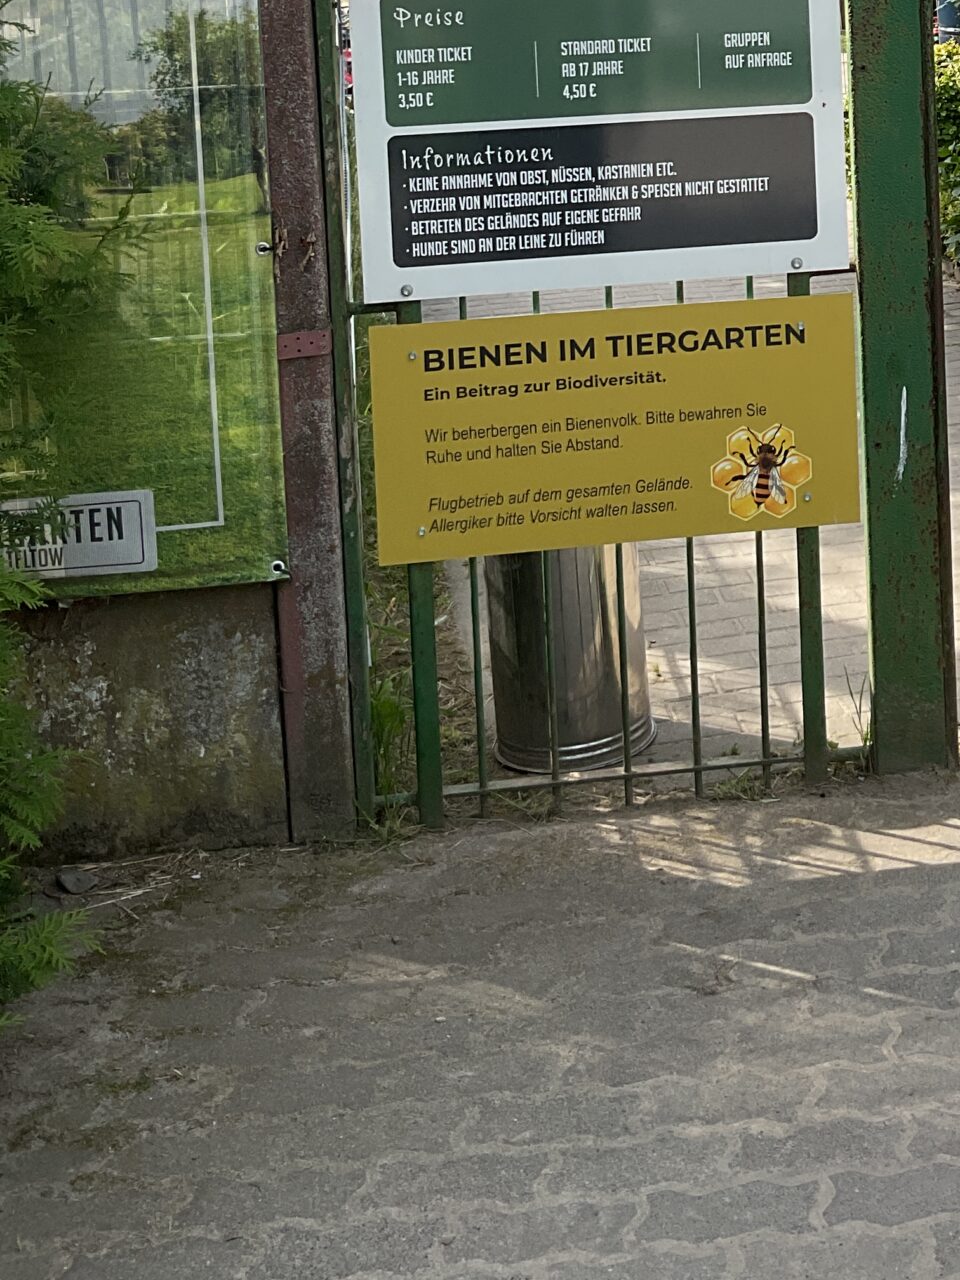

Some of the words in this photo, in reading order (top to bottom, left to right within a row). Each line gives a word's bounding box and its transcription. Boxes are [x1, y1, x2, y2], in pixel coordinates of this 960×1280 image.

[394, 7, 464, 28] Preise
[561, 40, 615, 56] STANDARD
[618, 37, 651, 53] TICKET
[724, 32, 770, 48] GRUPPEN
[396, 49, 435, 65] KINDER
[437, 47, 472, 62] TICKET
[562, 63, 576, 78] AB
[579, 62, 589, 76] 17
[592, 60, 624, 75] JAHRE
[725, 54, 745, 69] AUF
[747, 52, 792, 67] ANFRAGE
[397, 72, 419, 86] 1-16
[422, 69, 455, 85] JAHRE
[399, 93, 423, 110] 3,50
[426, 92, 434, 106] €
[563, 84, 587, 100] 4,50
[589, 83, 597, 98] €
[402, 145, 554, 170] Informationen
[409, 176, 439, 192] KEINE
[442, 172, 493, 191] ANNAHME
[495, 171, 518, 186] VON
[520, 170, 549, 186] OBST,
[551, 166, 595, 183] NÜSSEN,
[597, 163, 653, 180] KASTANIEN
[656, 162, 677, 176] ETC.
[410, 197, 456, 214] VERZEHR
[459, 196, 481, 210] VON
[483, 189, 568, 209] MITGEBRACHTEN
[570, 184, 629, 203] GETRÄNKEN
[632, 186, 639, 199] &
[641, 182, 682, 198] SPEISEN
[685, 181, 714, 196] NICHT
[716, 176, 769, 193] GESTATTET
[411, 220, 462, 236] BETRETEN
[465, 217, 485, 232] DES
[487, 213, 539, 231] GELÄNDES
[542, 212, 562, 226] AUF
[565, 209, 599, 225] EIGENE
[602, 206, 641, 222] GEFAHR
[412, 241, 448, 257] HUNDE
[451, 239, 476, 254] SIND
[478, 238, 493, 252] AN
[496, 236, 516, 251] DER
[519, 234, 547, 250] LEINE
[549, 233, 562, 248] ZU
[564, 229, 605, 246] FÜHREN
[424, 341, 547, 372] BIENEN
[559, 337, 595, 361] IM
[605, 323, 805, 357] TIERGARTEN
[424, 387, 450, 401] Ein
[456, 384, 518, 399] Beitrag
[524, 381, 550, 393] zur
[556, 370, 666, 391] Biodiversität.
[425, 429, 448, 443] Wir
[452, 421, 537, 441] beherbergen
[542, 420, 561, 433] ein
[566, 413, 641, 431] Bienenvolk.
[646, 410, 674, 425] Bitte
[679, 406, 742, 423] bewahren
[746, 403, 767, 417] Sie
[426, 450, 462, 464] Ruhe
[467, 445, 491, 461] und
[496, 443, 536, 458] halten
[541, 440, 562, 454] Sie
[566, 435, 623, 453] Abstand.
[428, 492, 504, 514] Flugbetrieb
[508, 489, 530, 505] auf
[533, 488, 562, 503] dem
[566, 483, 630, 502] gesamten
[636, 476, 693, 493] Gelände.
[429, 516, 491, 534] Allergiker
[496, 513, 525, 527] bitte
[530, 505, 581, 524] Vorsicht
[586, 504, 628, 519] walten
[632, 500, 677, 515] lassen.
